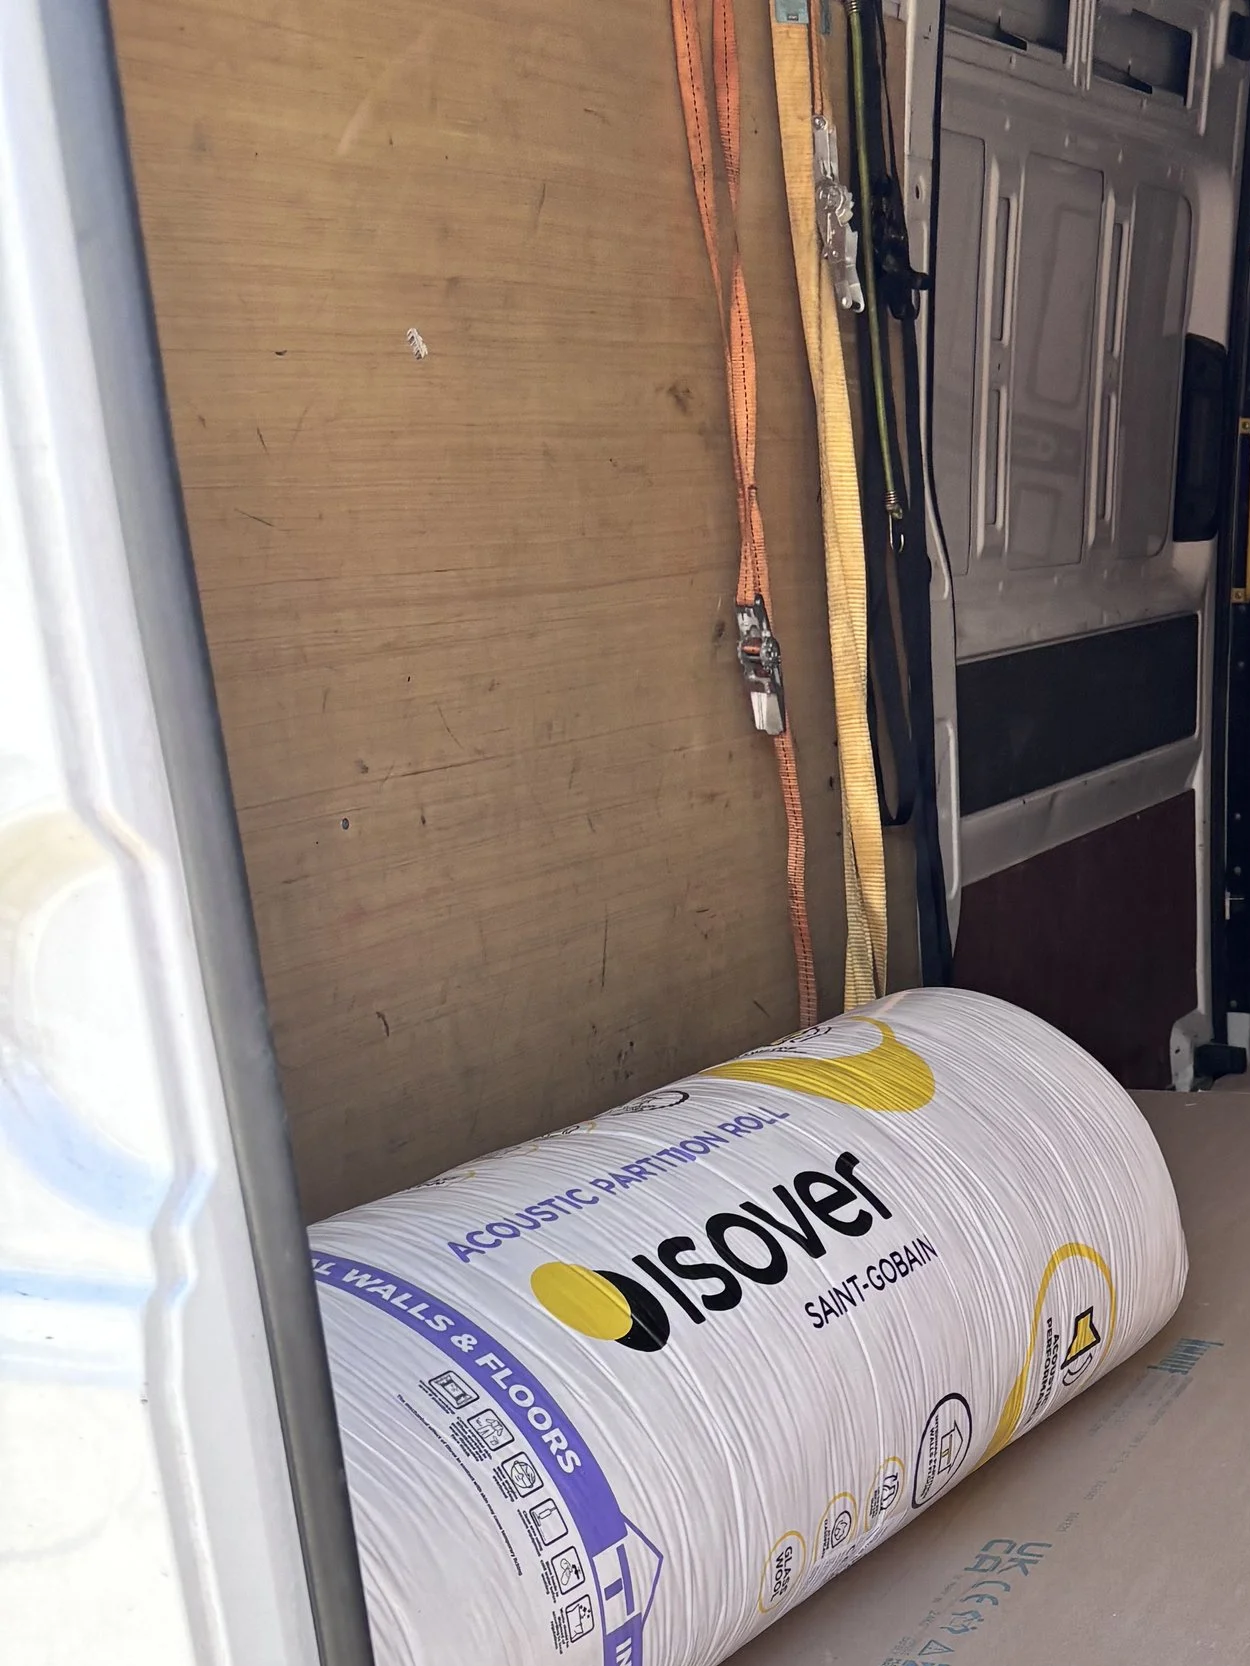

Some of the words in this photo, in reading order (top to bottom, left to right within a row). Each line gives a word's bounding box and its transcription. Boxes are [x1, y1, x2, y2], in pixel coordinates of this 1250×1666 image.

[448, 1188, 599, 1263] ACOUSTIC
[589, 1131, 730, 1195] PARTITION
[717, 1106, 790, 1138] ROLL
[804, 1236, 937, 1329] SAINT-GOBAIN
[342, 1268, 455, 1332] WALLS
[450, 1333, 478, 1353] &
[475, 1352, 582, 1474] FLOORS
[770, 1551, 785, 1601] WOOL
[998, 1542, 1052, 1577] UK
